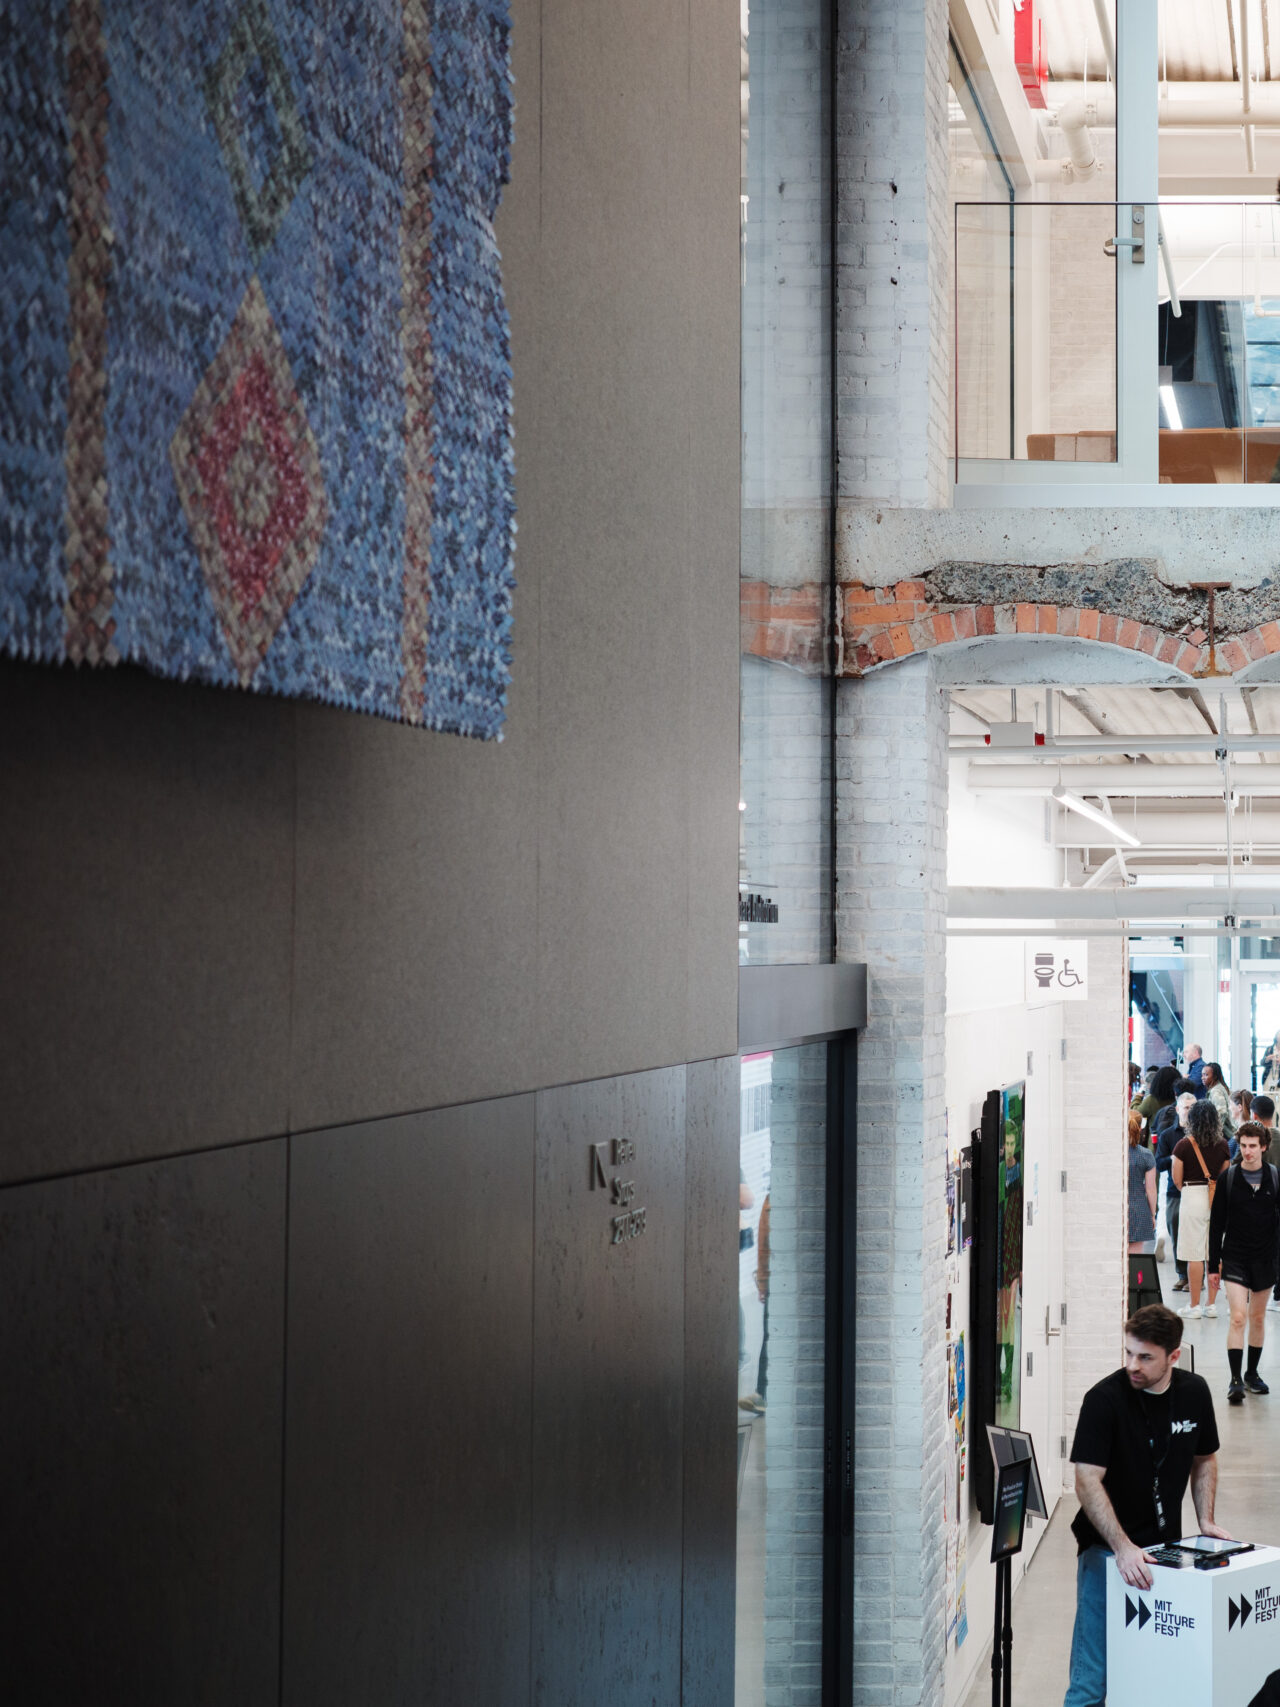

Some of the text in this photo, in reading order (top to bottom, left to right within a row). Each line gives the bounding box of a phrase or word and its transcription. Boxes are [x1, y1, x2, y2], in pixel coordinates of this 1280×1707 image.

[1255, 1586, 1271, 1600] MIT
[1154, 1599, 1172, 1612] MIT
[1154, 1611, 1195, 1629] FUTURE
[1255, 1607, 1278, 1624] FEST
[1154, 1622, 1180, 1637] FEST
